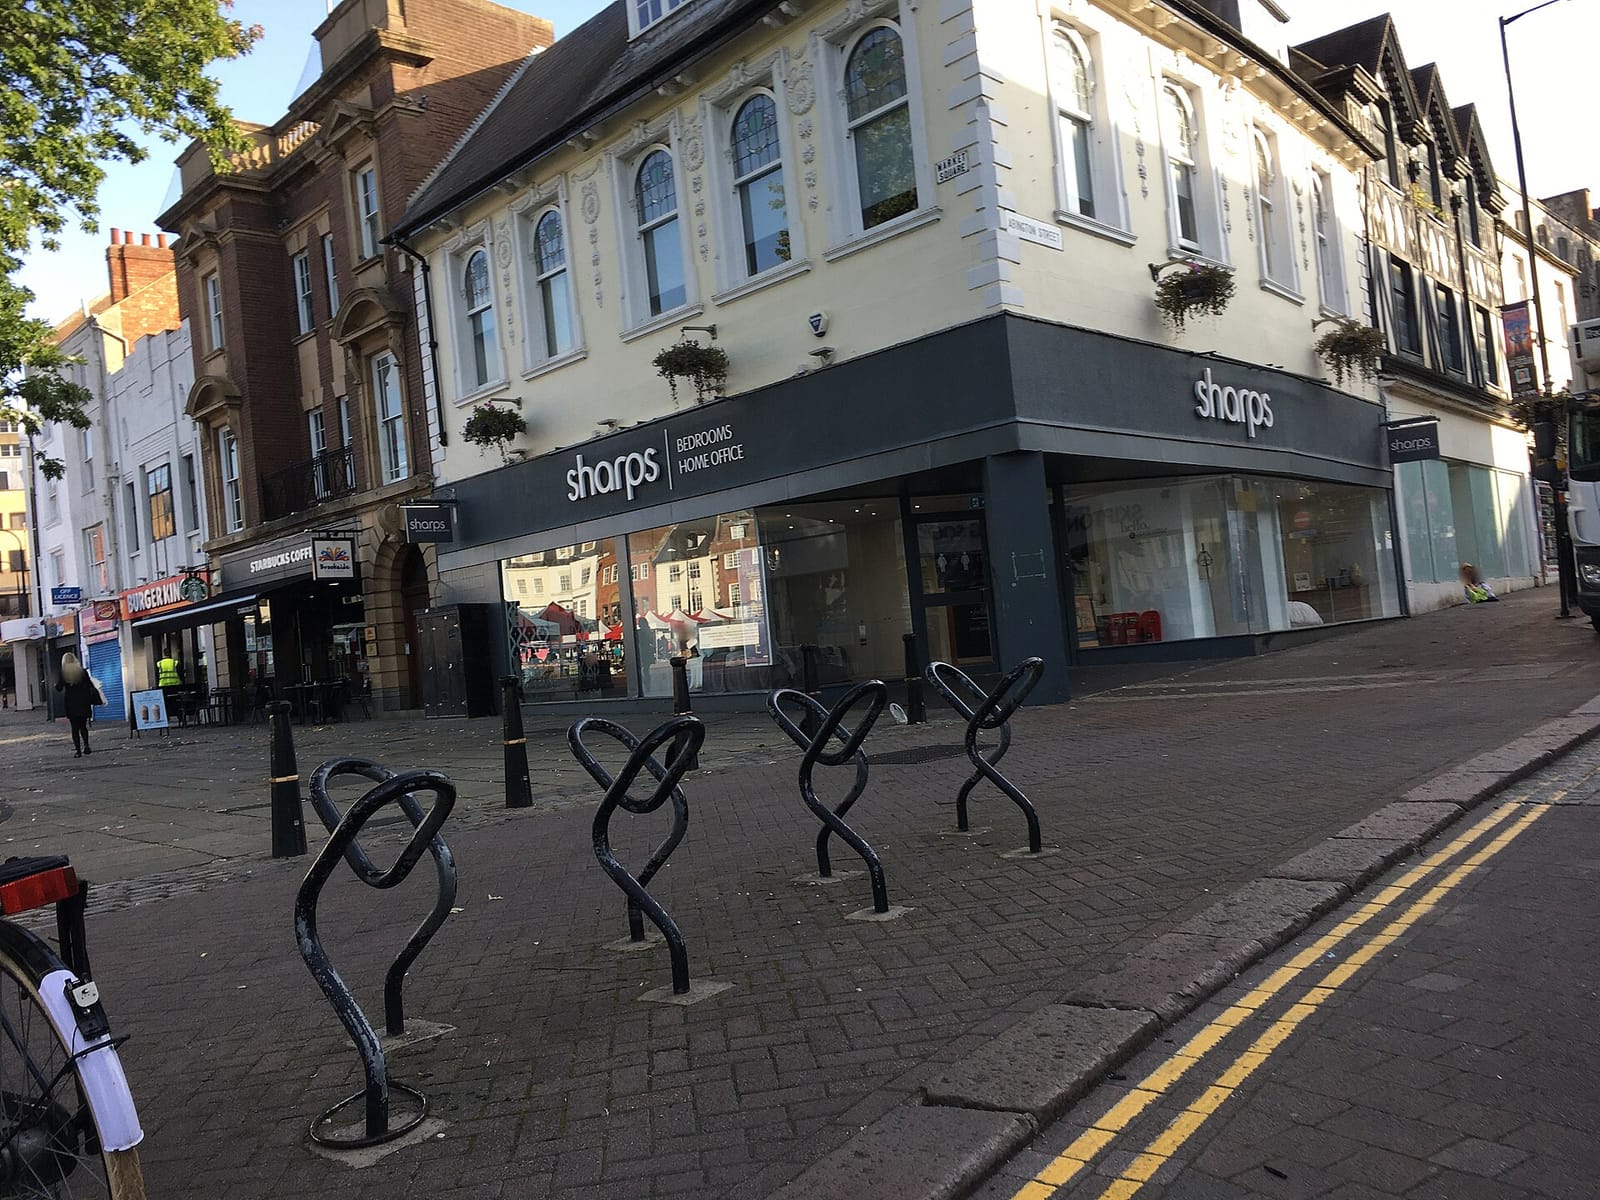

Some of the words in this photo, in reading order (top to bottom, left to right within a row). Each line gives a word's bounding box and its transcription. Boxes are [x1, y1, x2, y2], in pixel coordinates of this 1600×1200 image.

[937, 152, 966, 171] MARKET
[939, 162, 967, 180] SQUARE
[1038, 226, 1060, 243] STREET
[1194, 367, 1274, 438] sharps
[676, 424, 733, 453] BEDROOMS
[1390, 437, 1432, 451] sharps
[678, 453, 710, 474] HOME
[710, 443, 745, 466] OFFICE
[566, 447, 660, 502] sharps
[409, 518, 446, 532] sharps
[249, 551, 290, 573] STARBUCKS
[127, 587, 163, 613] BURGER
